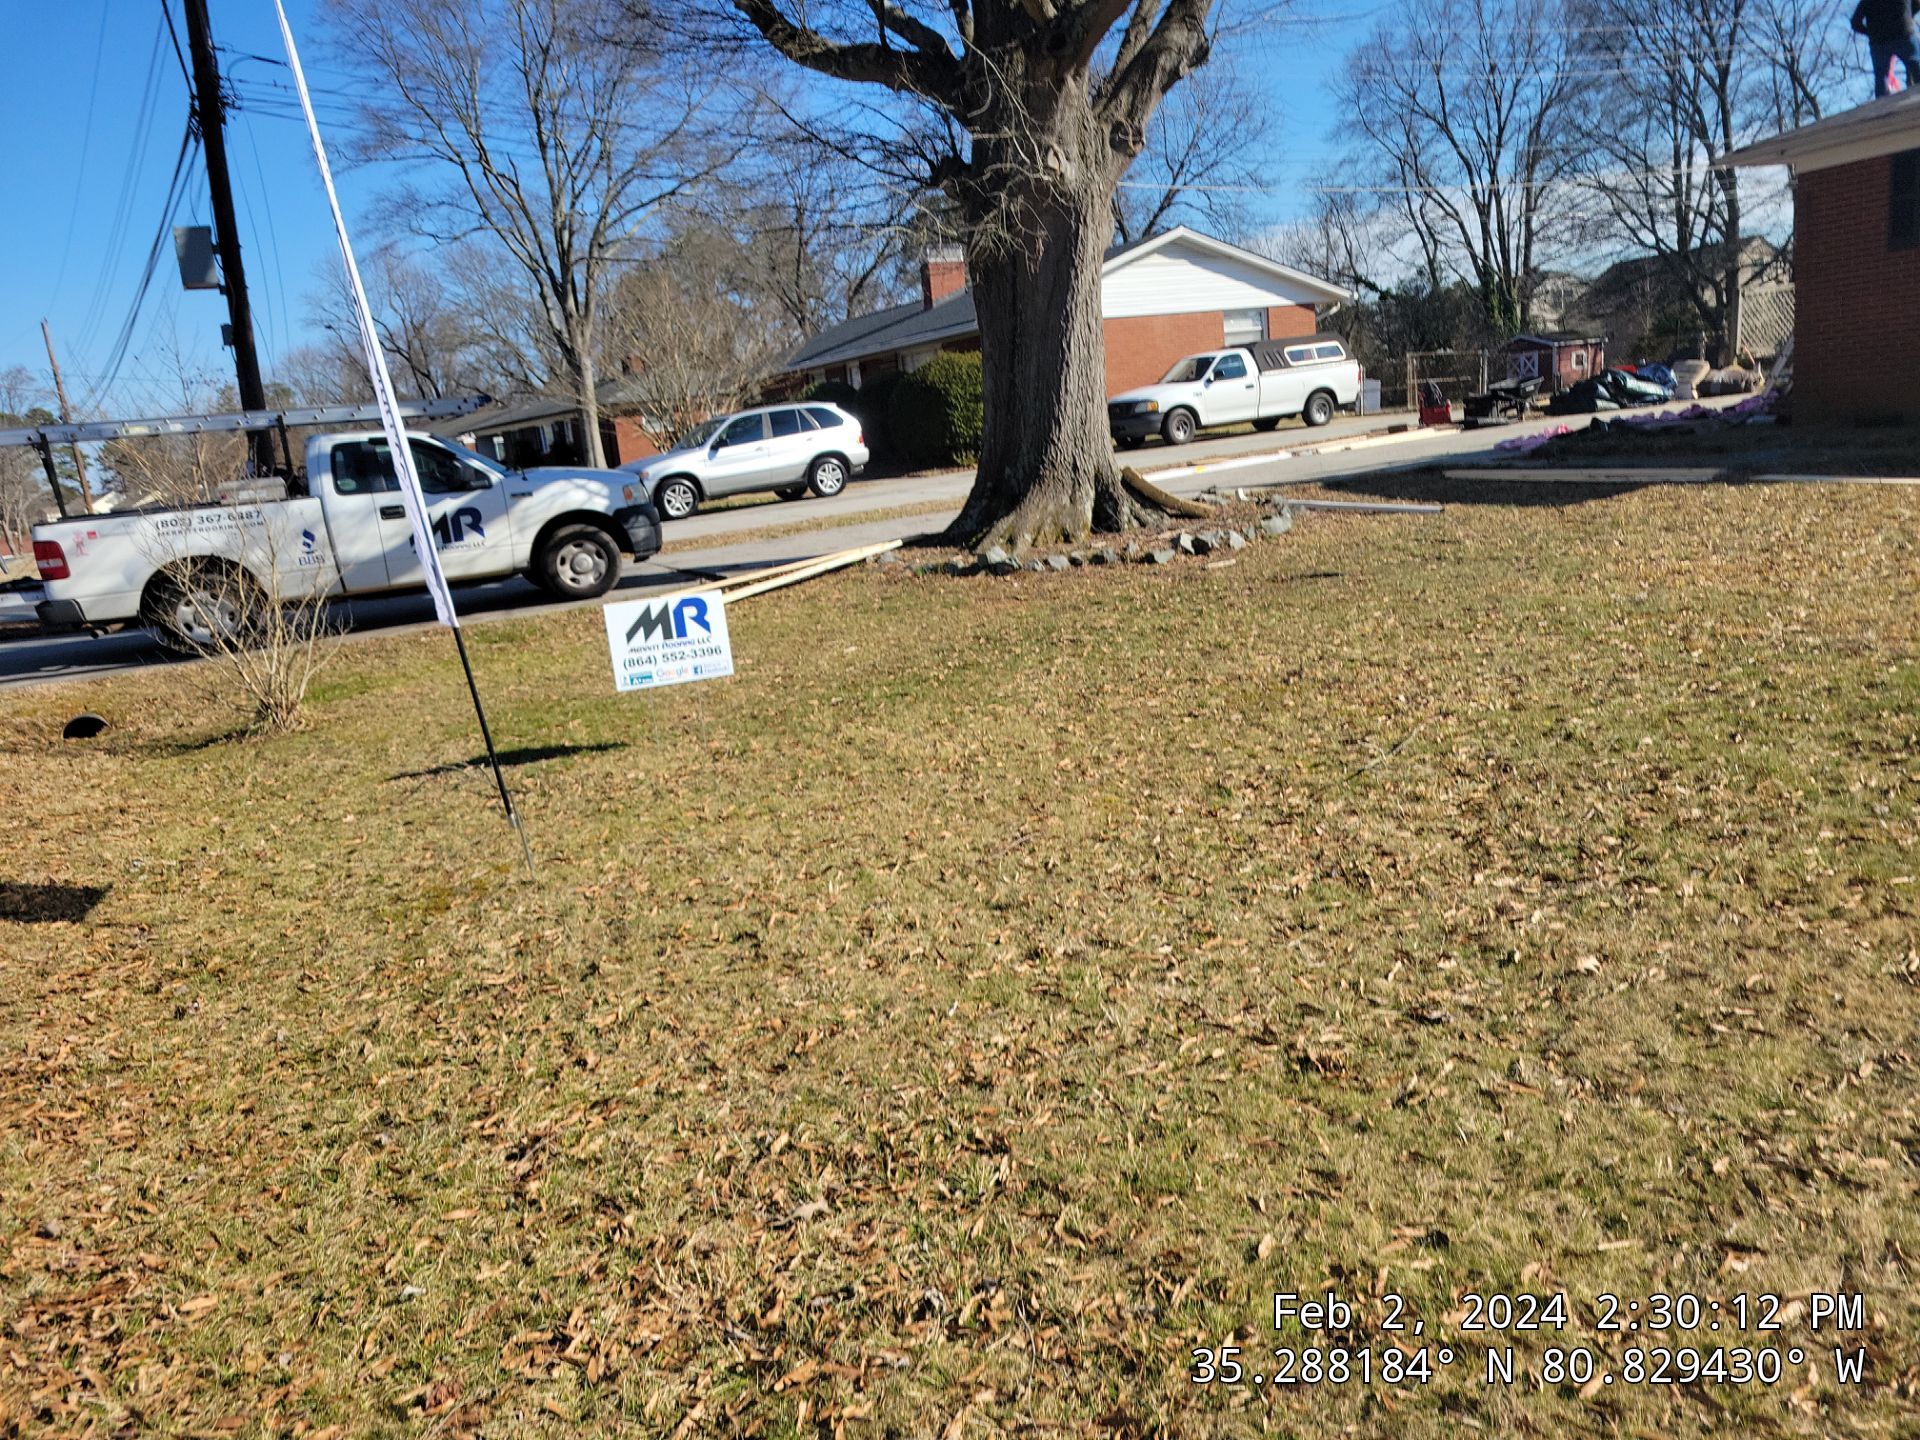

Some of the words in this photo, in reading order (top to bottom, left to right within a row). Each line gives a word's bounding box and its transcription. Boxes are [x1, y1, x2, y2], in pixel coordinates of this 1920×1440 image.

[626, 598, 711, 644] MR
[623, 655, 658, 671] (864)
[662, 646, 722, 663] 552-3396
[656, 665, 689, 678] Google
